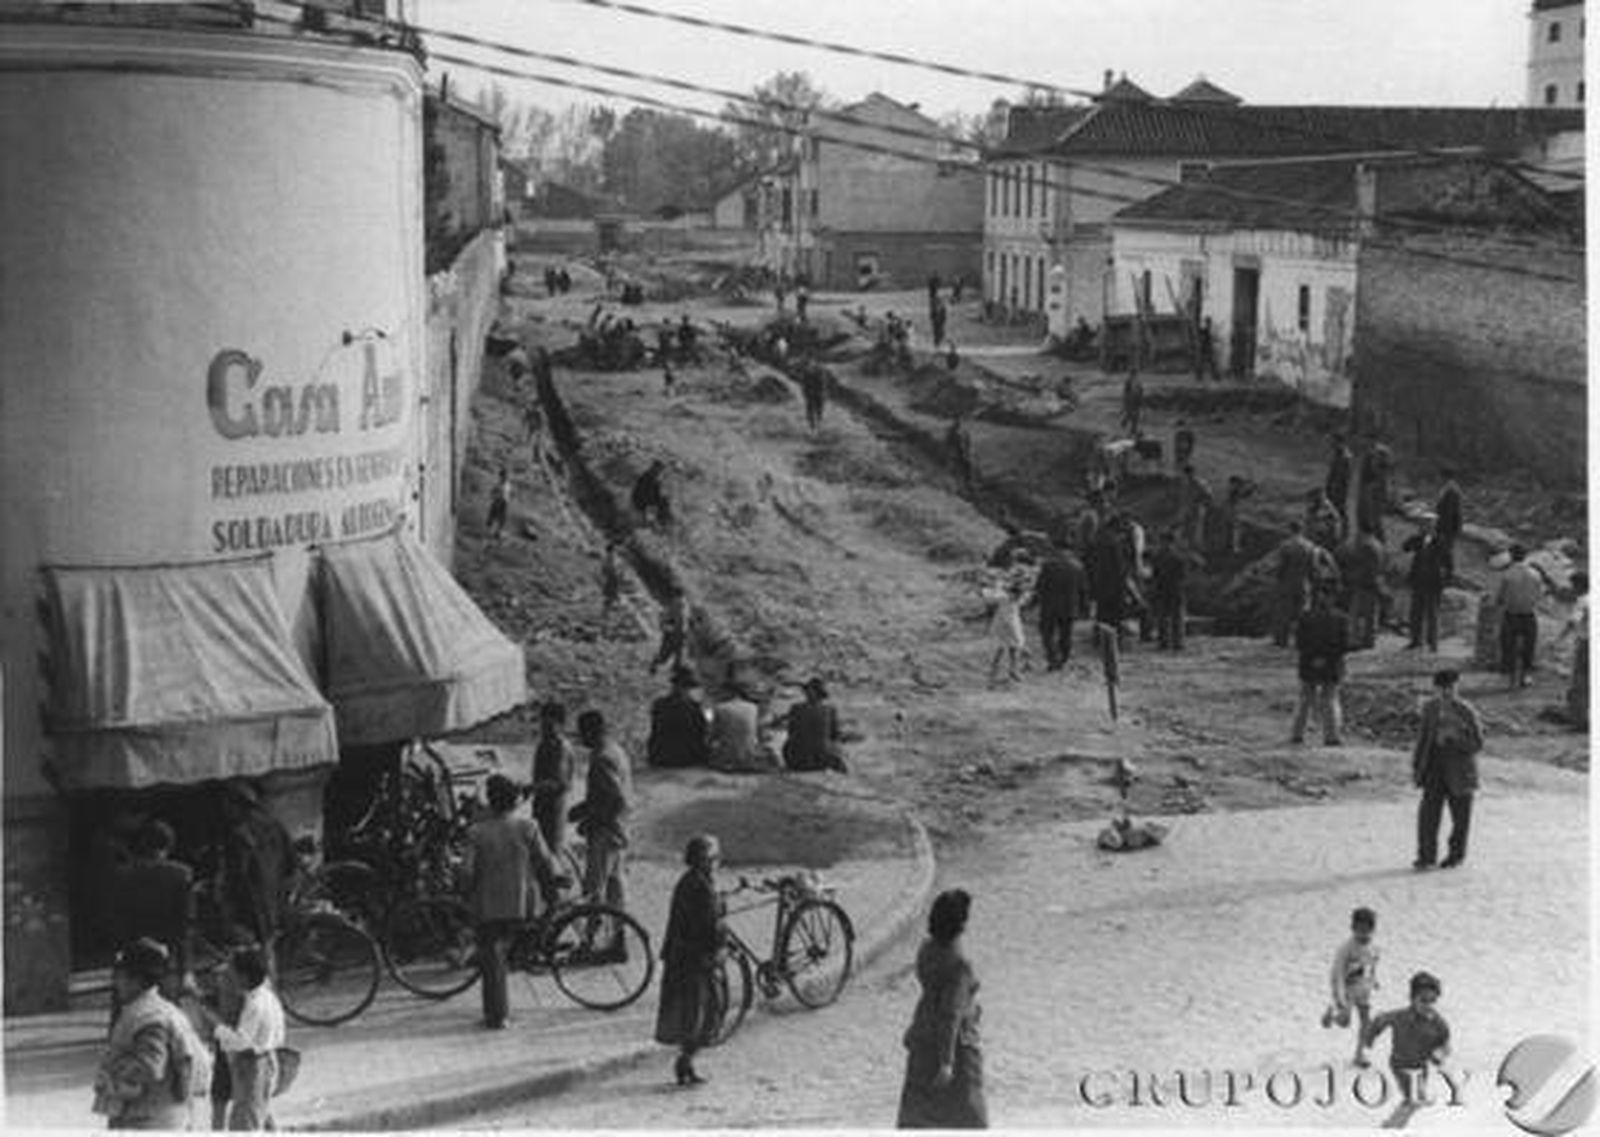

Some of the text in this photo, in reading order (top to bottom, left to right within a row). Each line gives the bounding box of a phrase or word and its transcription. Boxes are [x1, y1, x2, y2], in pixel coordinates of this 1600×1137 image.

[206, 348, 340, 440] Casa
[211, 456, 334, 499] REPARACIONES
[212, 511, 333, 553] SOLDADURA
